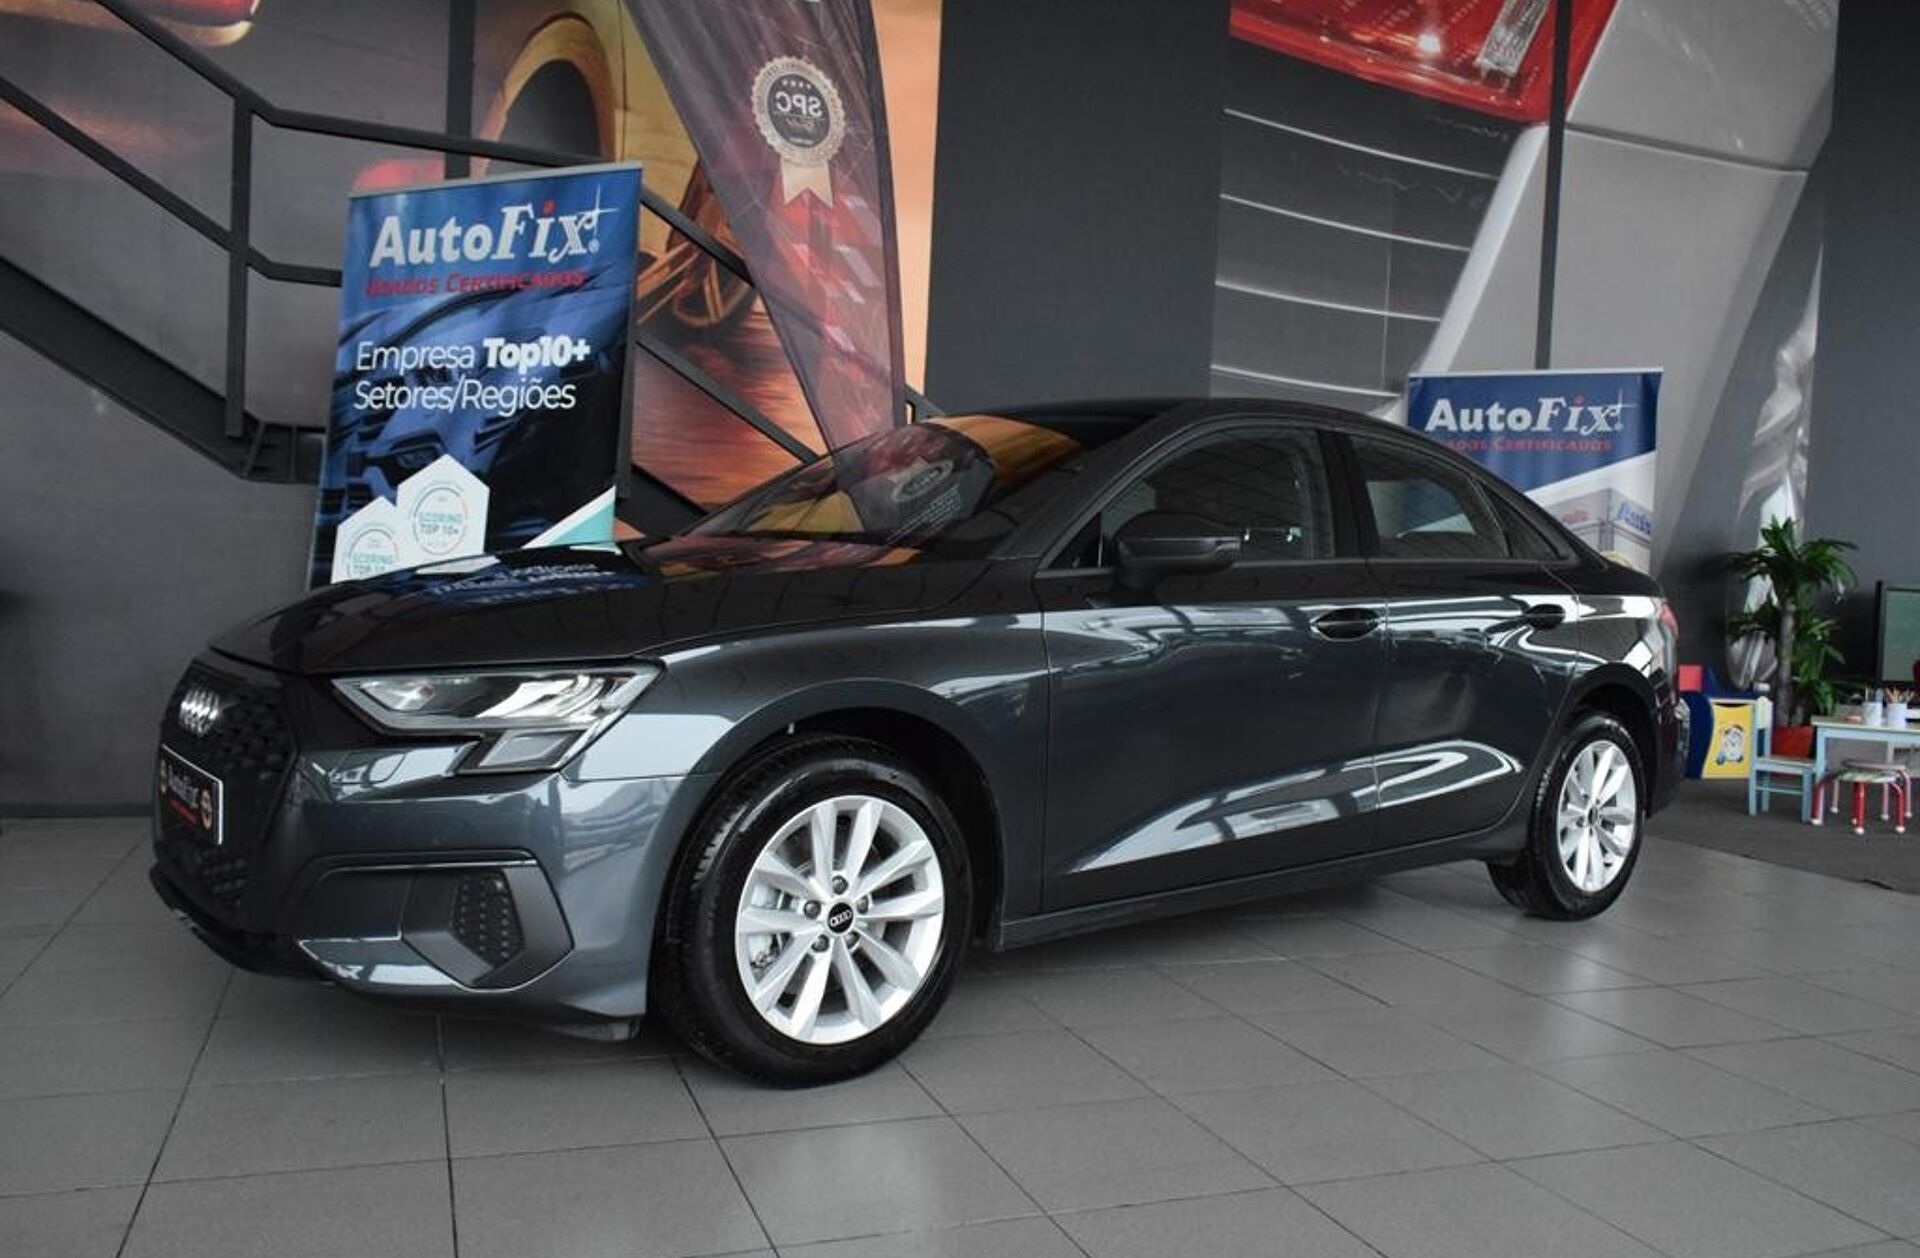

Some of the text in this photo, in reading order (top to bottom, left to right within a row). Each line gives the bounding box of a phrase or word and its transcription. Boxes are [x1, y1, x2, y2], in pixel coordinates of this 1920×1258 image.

[356, 335, 591, 375] Empresa Top10+
[354, 376, 576, 418] Setores/Regiões
